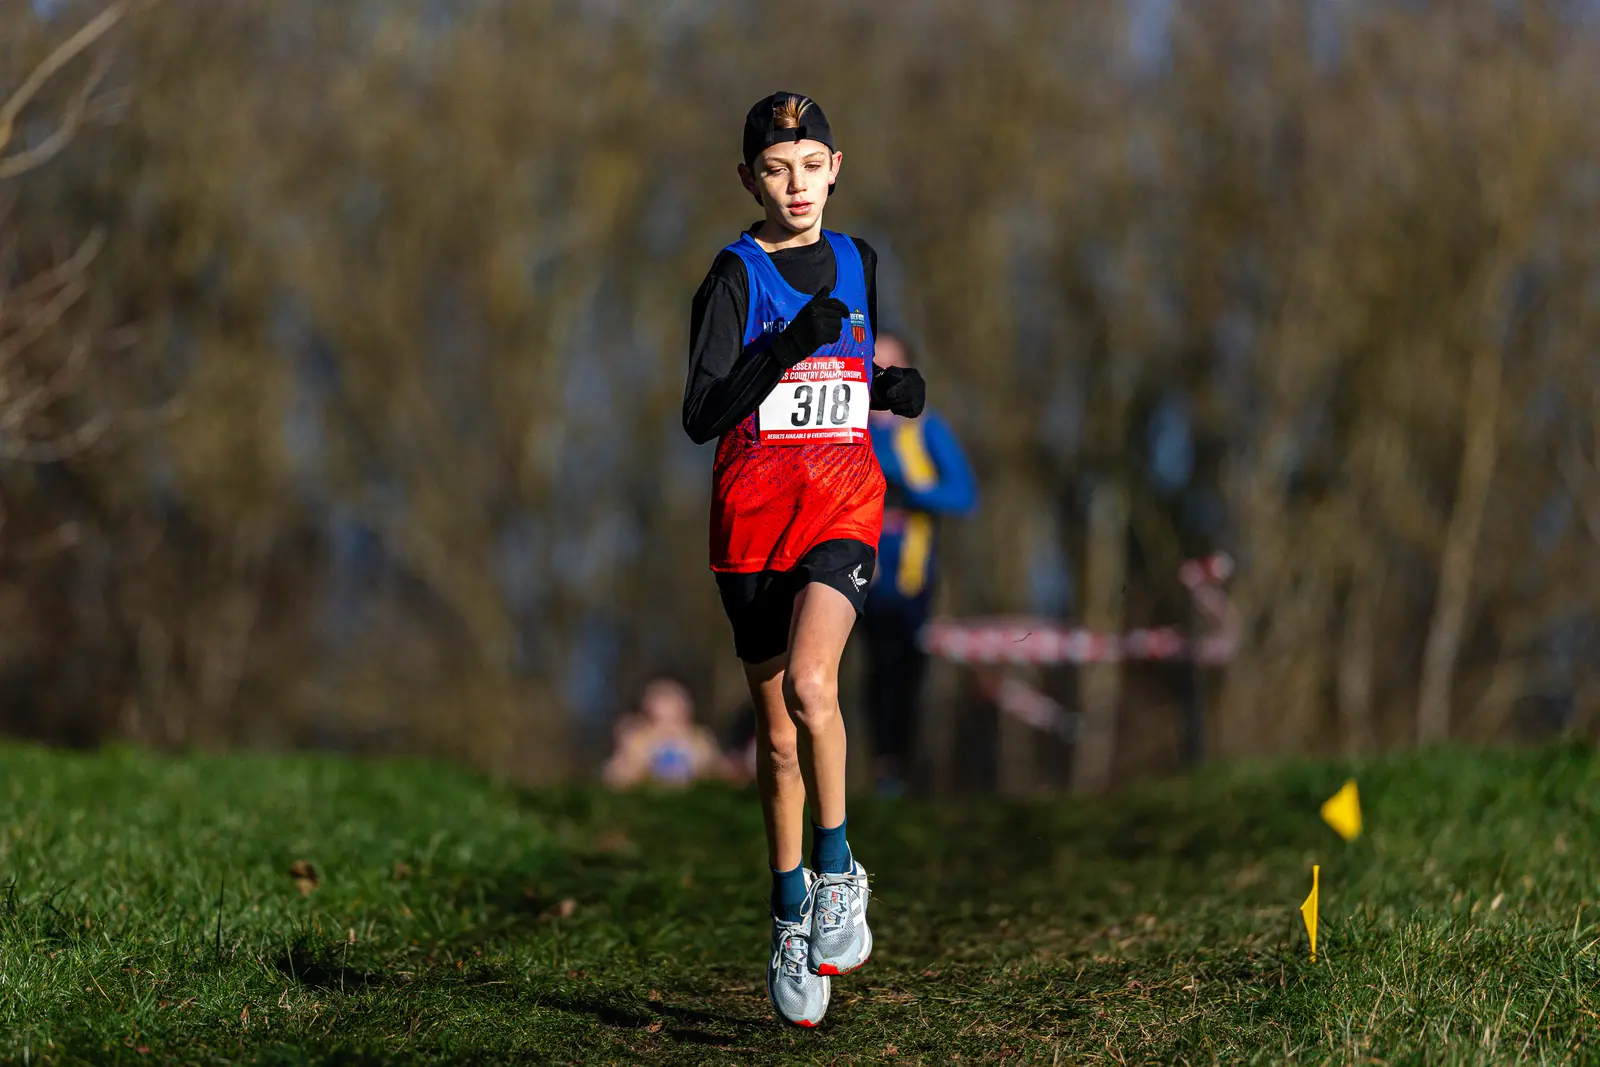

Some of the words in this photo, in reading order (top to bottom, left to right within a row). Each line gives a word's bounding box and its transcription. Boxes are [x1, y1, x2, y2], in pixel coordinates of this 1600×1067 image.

[792, 363, 812, 371] ESSEX
[812, 361, 845, 370] ATHLETICS
[789, 372, 818, 380] COUNTRY
[819, 370, 862, 380] CHAMPIONSHIPS
[790, 384, 851, 427] 318
